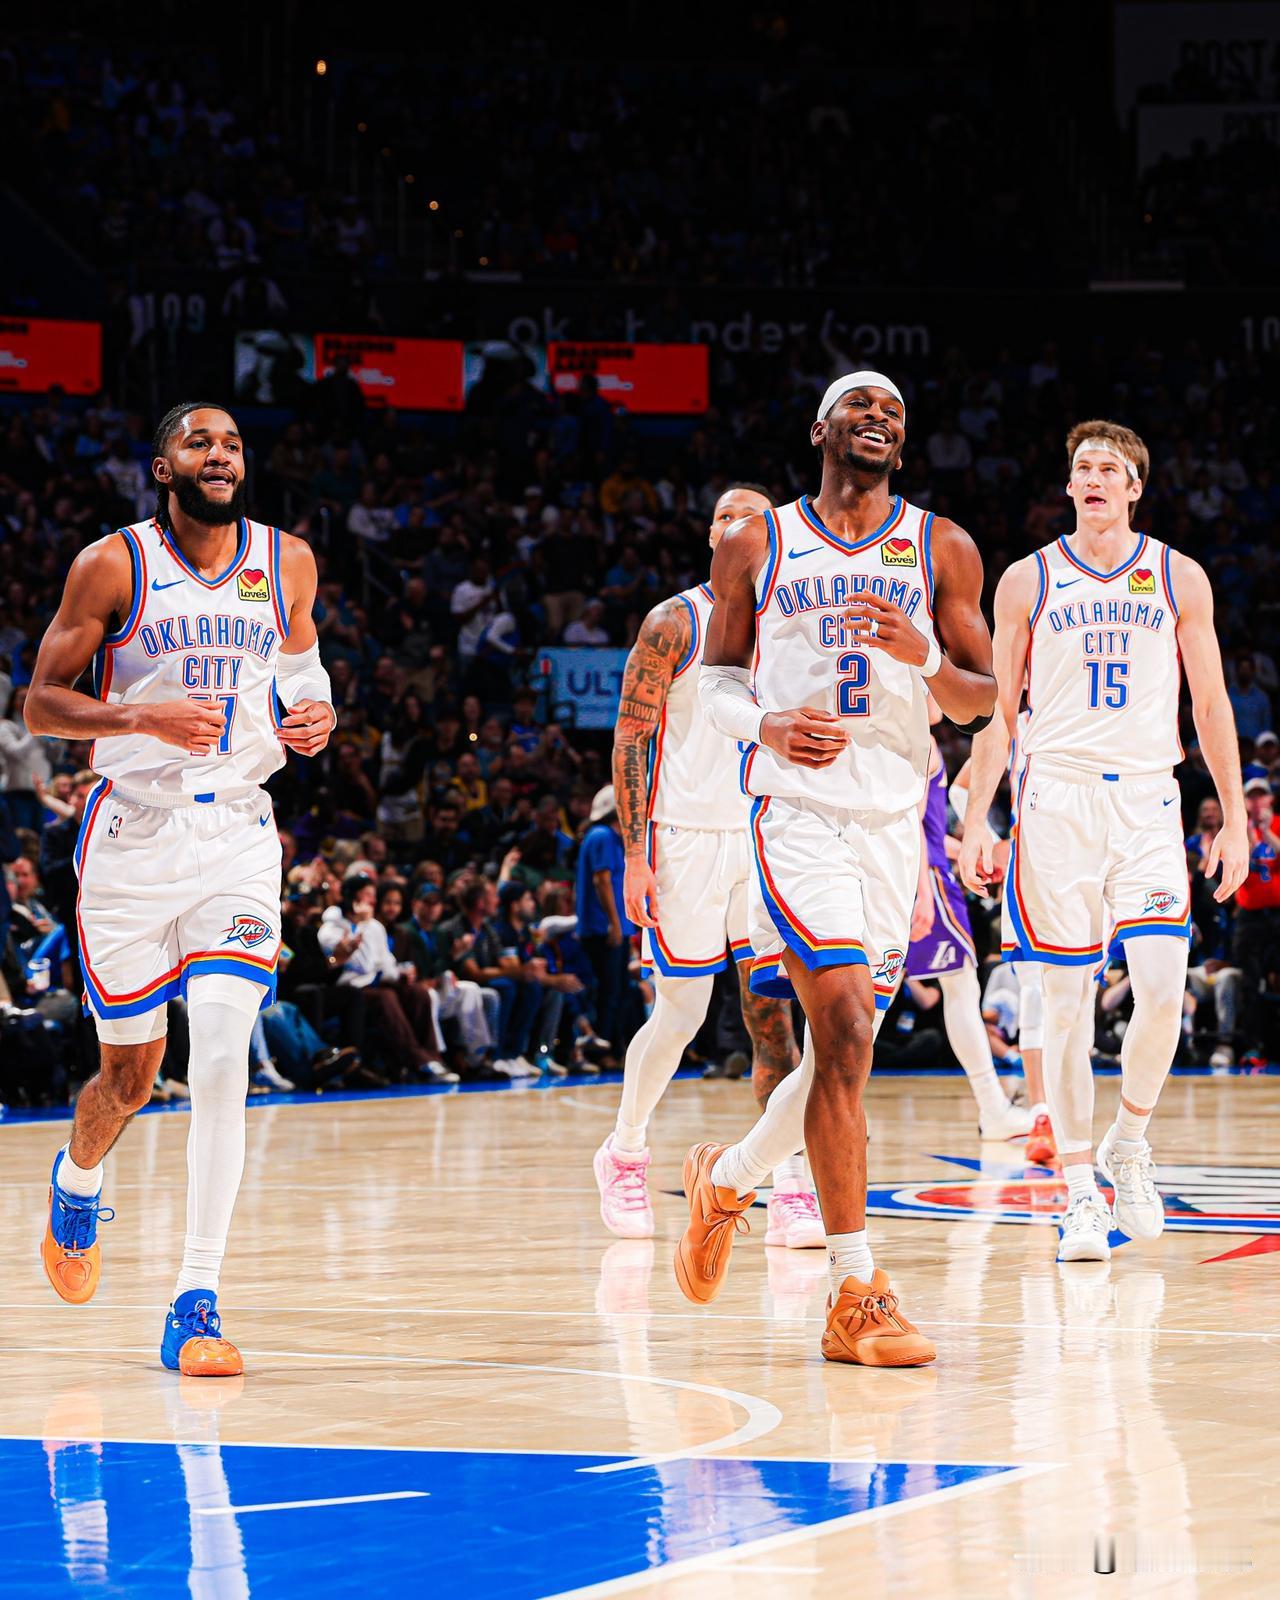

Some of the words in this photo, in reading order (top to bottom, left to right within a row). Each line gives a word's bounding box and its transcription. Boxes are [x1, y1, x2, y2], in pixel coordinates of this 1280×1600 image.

[774, 574, 923, 620] OKLAHOMA
[1047, 599, 1165, 634] OKLAHOMA
[138, 614, 278, 663] OKLAHOMA
[1083, 630, 1132, 656] CITY
[182, 654, 244, 690] CITY
[836, 651, 870, 717] 2
[1083, 659, 1131, 712] 15
[187, 693, 239, 756] 7
